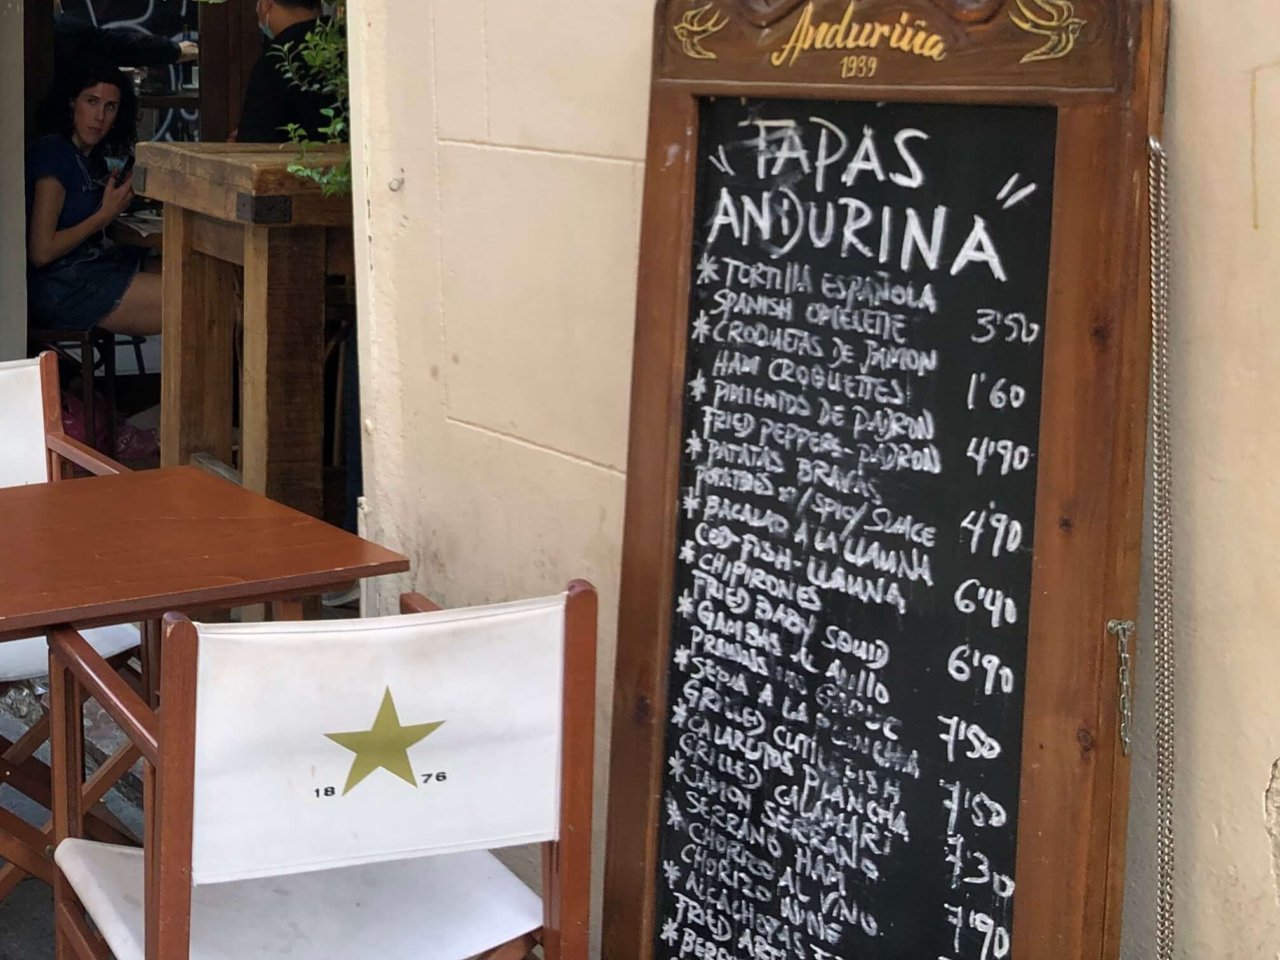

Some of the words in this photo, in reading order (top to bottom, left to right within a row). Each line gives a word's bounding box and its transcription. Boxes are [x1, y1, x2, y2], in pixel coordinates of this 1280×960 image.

[709, 289, 793, 322] SPANISH
[822, 270, 938, 313] ESPAÑOLA
[713, 320, 824, 357] CROQUETAS
[827, 337, 856, 369] DE
[859, 339, 939, 376] JAMON
[711, 349, 761, 377] HAM
[768, 358, 906, 406] CROQUETTES
[701, 405, 755, 440] FRIED
[713, 379, 811, 417] PIMIENTOS
[817, 397, 846, 427] DE
[707, 439, 786, 474] PATATAS
[815, 530, 838, 555] LA
[698, 553, 823, 612] CHIPIRONES
[691, 569, 751, 615] FRIED
[821, 625, 891, 670] SQUID
[697, 600, 783, 657] GAMBAS
[758, 683, 774, 707] A
[782, 696, 809, 723] LA
[314, 786, 336, 799] 18
[421, 771, 448, 784] 76
[777, 866, 811, 903] AL
